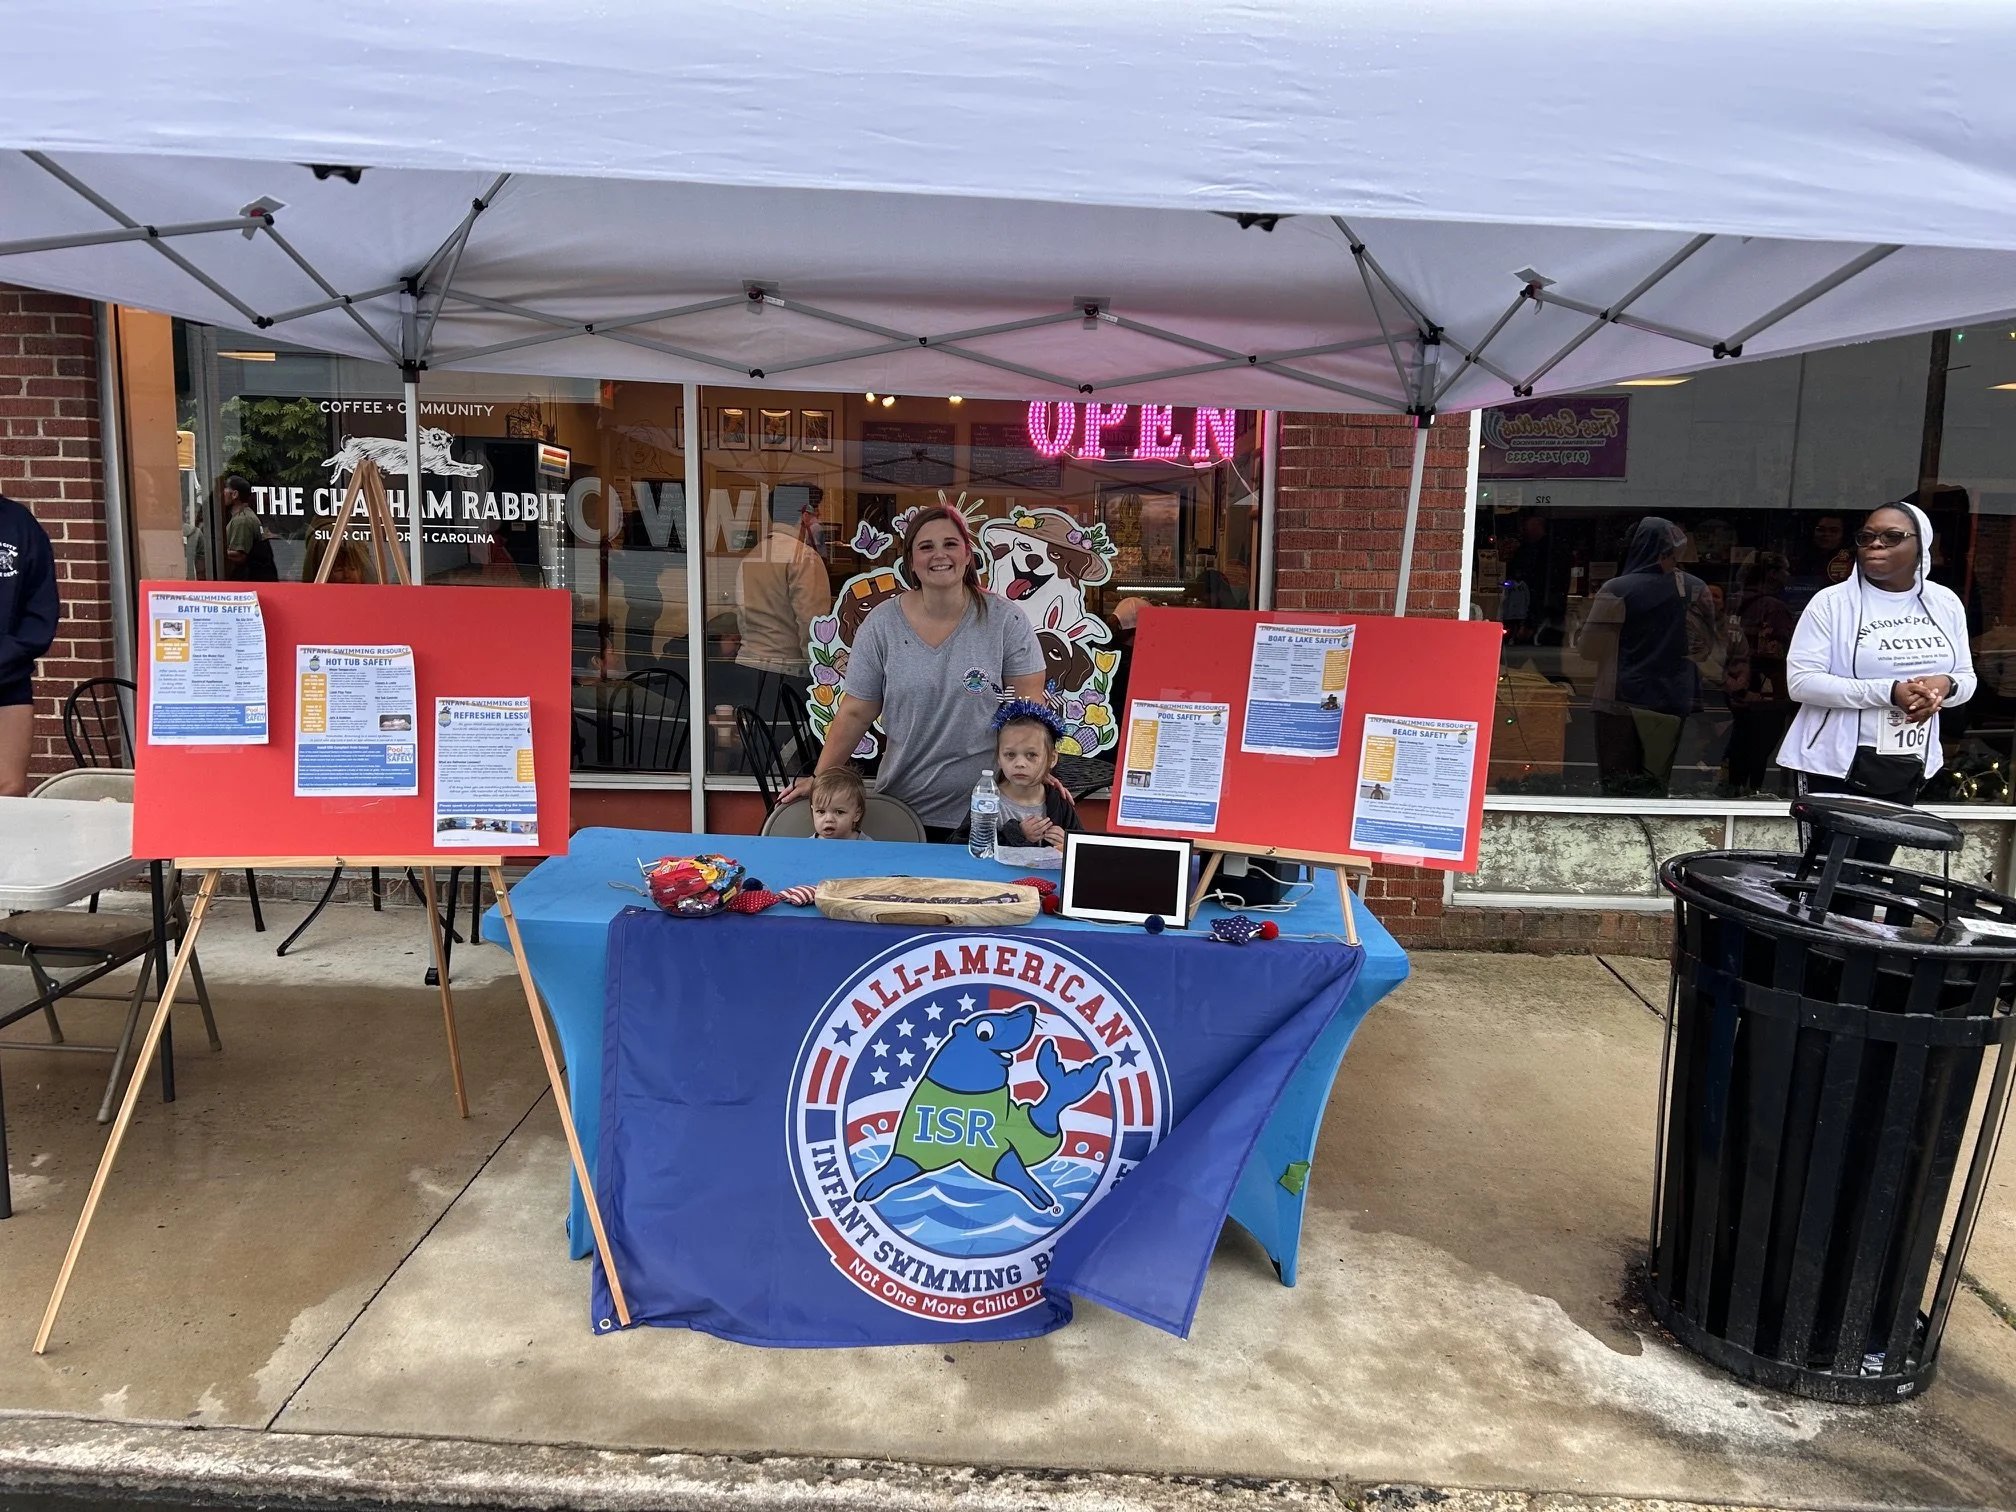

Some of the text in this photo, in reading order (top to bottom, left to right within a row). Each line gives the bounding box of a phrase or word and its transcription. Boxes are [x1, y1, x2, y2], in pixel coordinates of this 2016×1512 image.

[320, 401, 383, 413] COFFEE
[397, 402, 494, 417] CMMUNITY
[1027, 401, 1236, 458] OPEN
[251, 486, 566, 522] THE CHAHM RABBIT
[314, 529, 348, 541] SILR
[352, 529, 372, 541] CIT
[431, 532, 495, 544] CAROLINA
[222, 606, 251, 614] SAFETY
[1878, 636, 1945, 650] ACTIVE
[1177, 713, 1202, 721] SAFETY
[1398, 719, 1435, 728] SWIMMING
[1437, 721, 1473, 729] RESOURCE
[1393, 729, 1448, 739] BEACH SAFETY
[1894, 728, 1925, 748] 106
[851, 944, 1132, 1047] ALL-AMERICAN
[914, 1106, 998, 1148] ISR
[812, 1144, 1023, 1293] INFANT SWIMMING
[849, 1257, 880, 1288] Not
[882, 1281, 917, 1307] One
[922, 1297, 967, 1316] More
[972, 1291, 1019, 1315] Child
